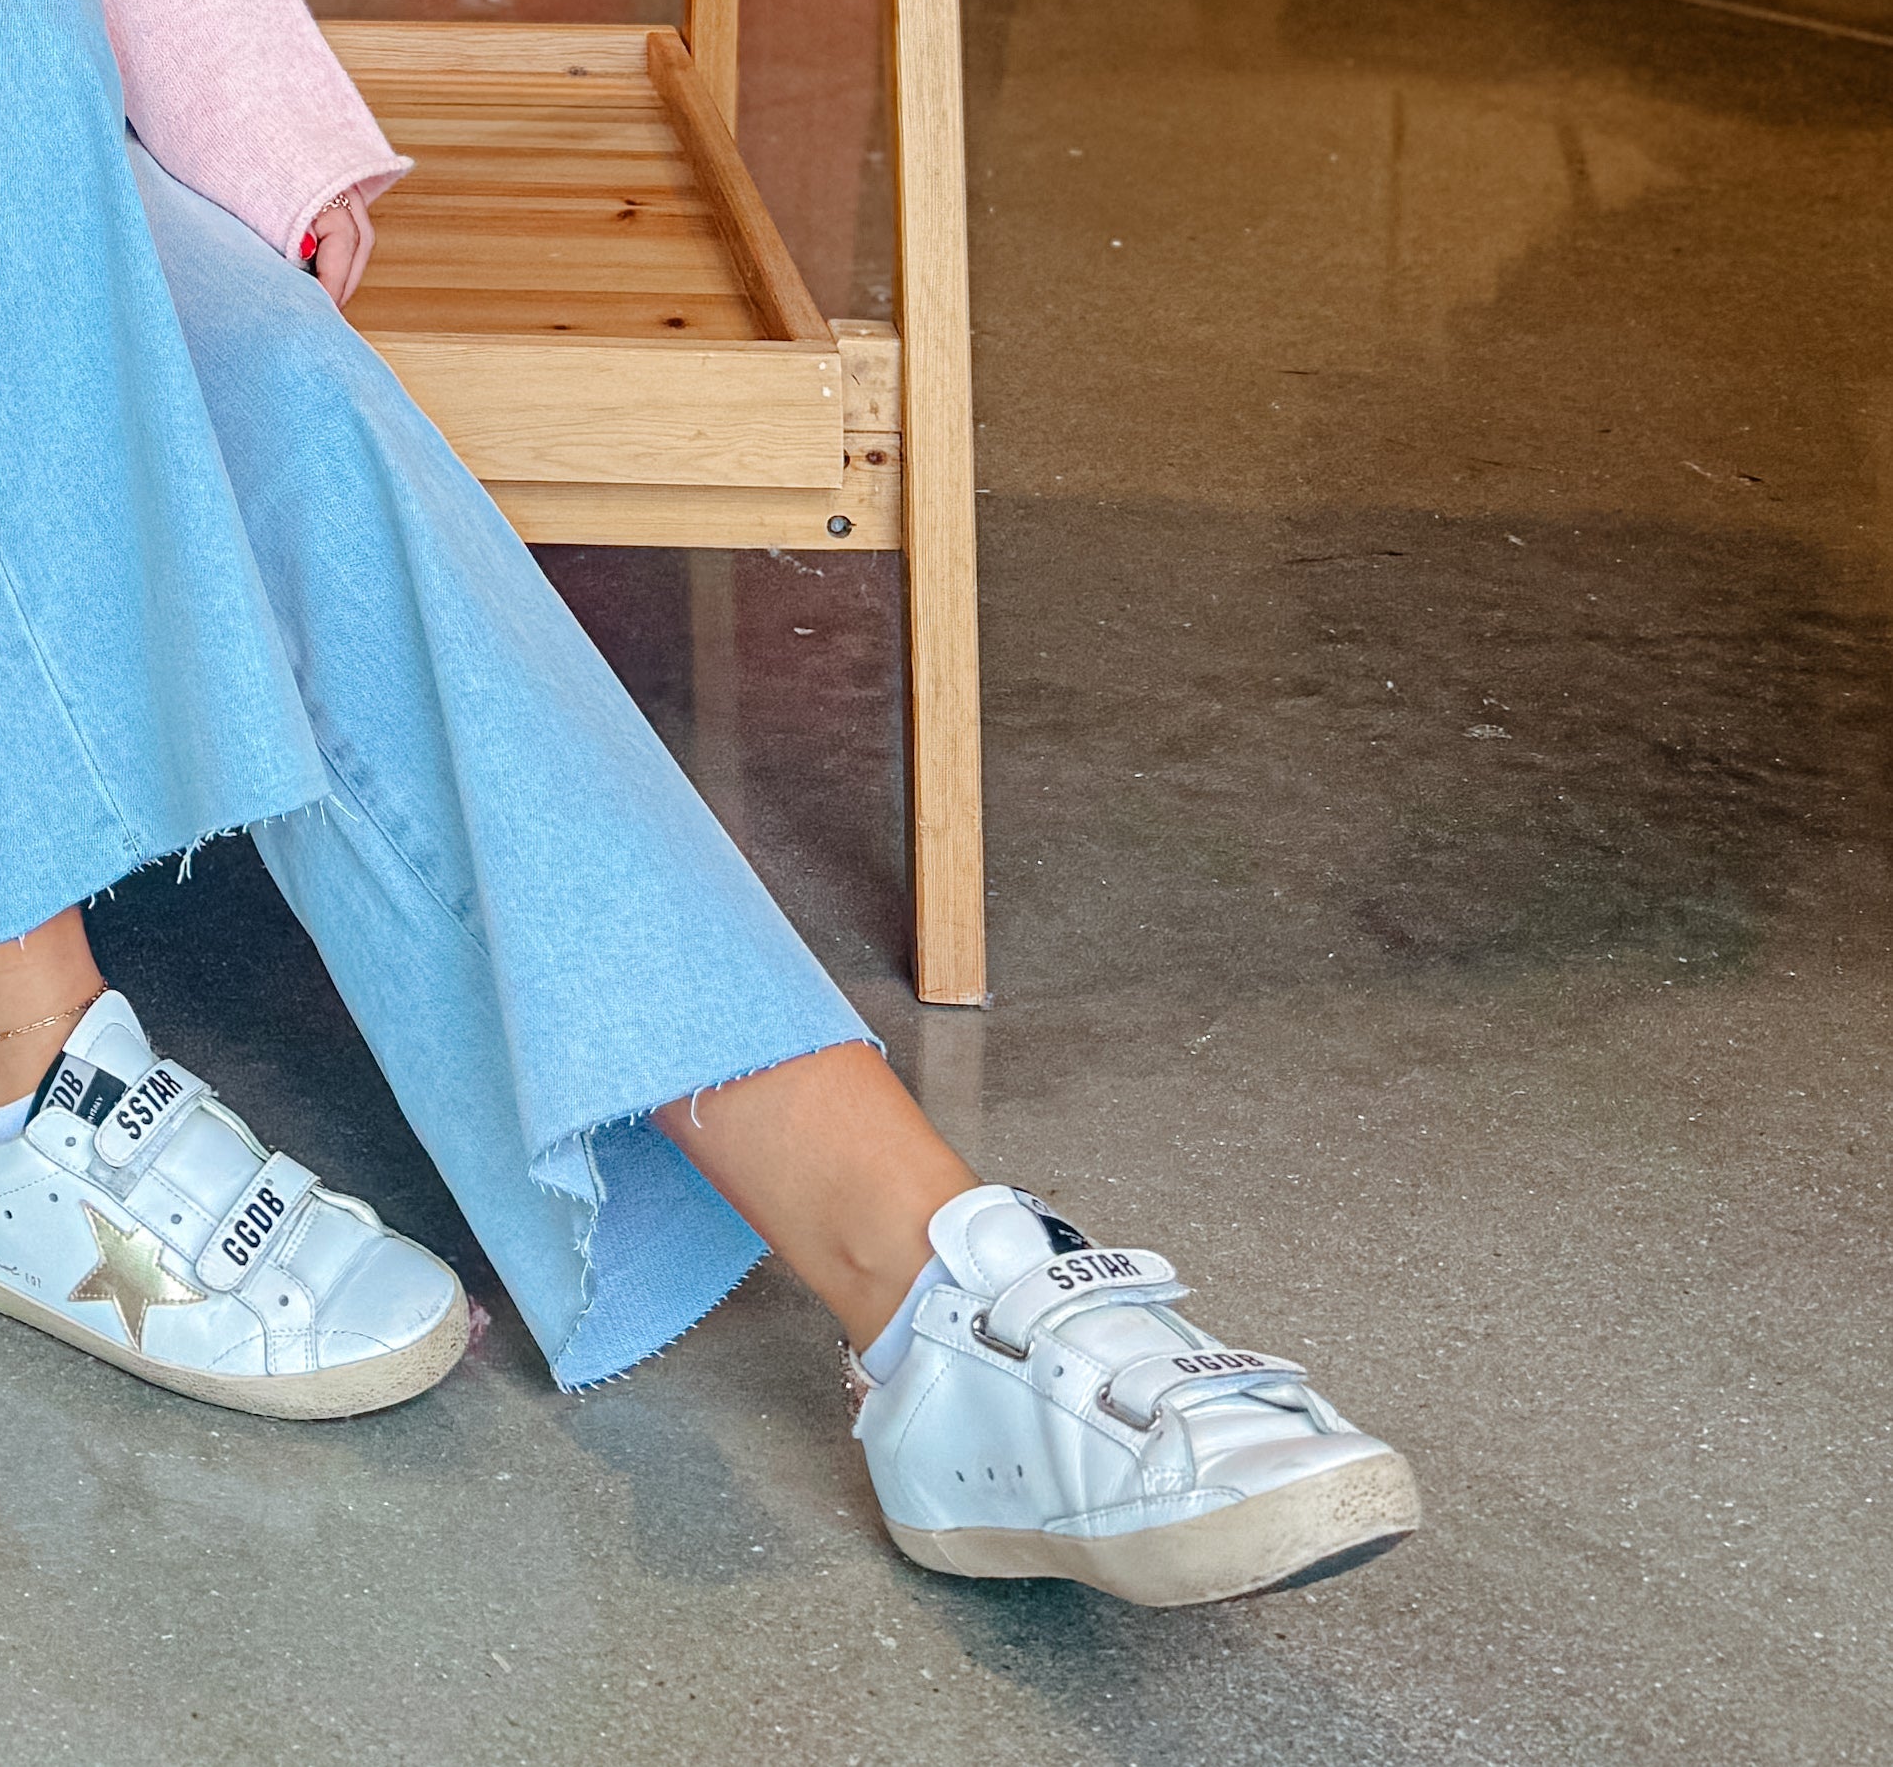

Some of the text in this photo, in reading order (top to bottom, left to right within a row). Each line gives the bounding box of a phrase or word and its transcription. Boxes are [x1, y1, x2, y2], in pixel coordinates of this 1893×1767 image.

[116, 1069, 184, 1140] SSTAR
[221, 1186, 285, 1267] GGDB
[1046, 1253, 1142, 1290] SSTAR
[1171, 1353, 1265, 1374] GGDB
